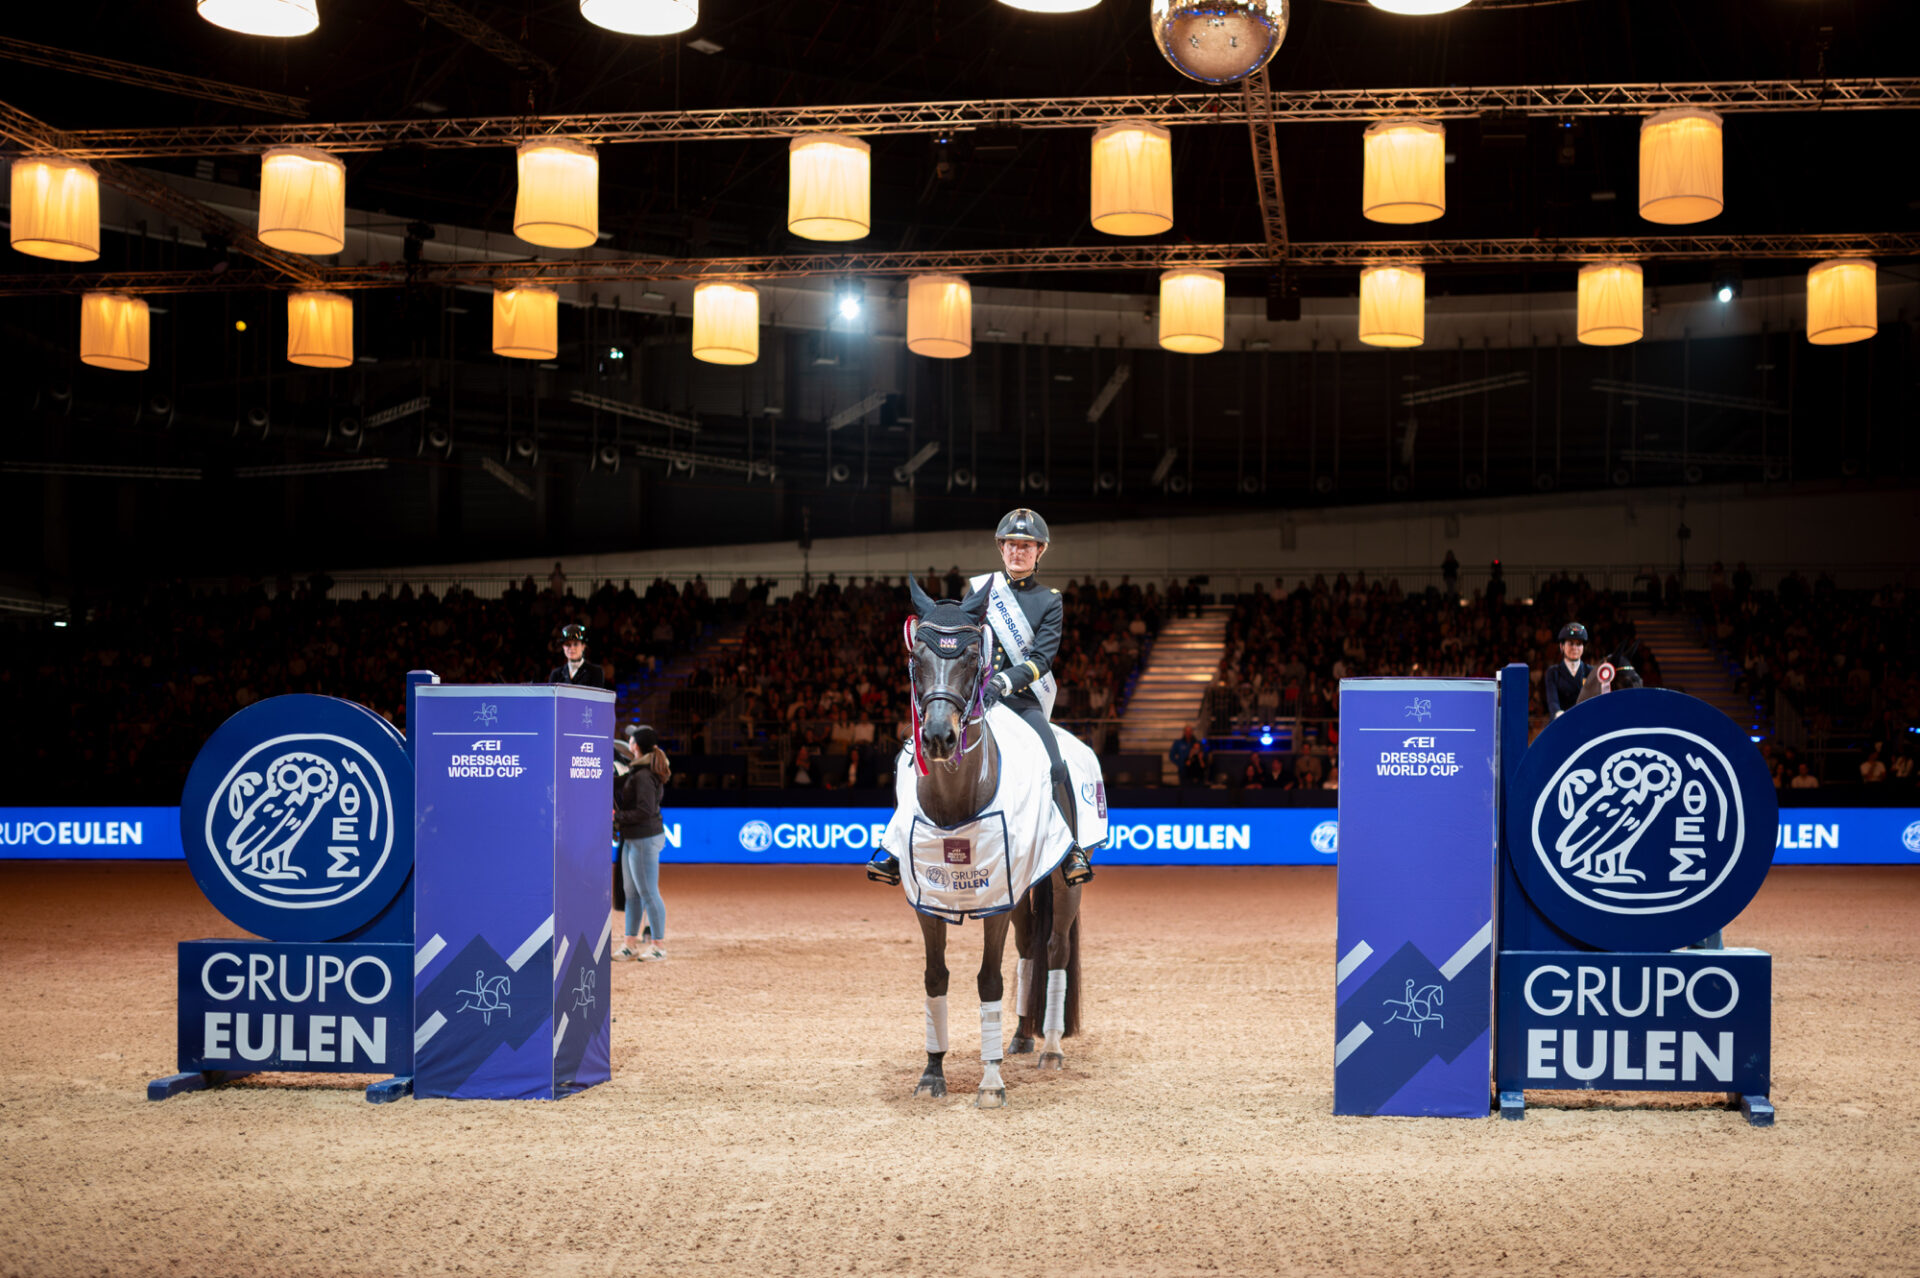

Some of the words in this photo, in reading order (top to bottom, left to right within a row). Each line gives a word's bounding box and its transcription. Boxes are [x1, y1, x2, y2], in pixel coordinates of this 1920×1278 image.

[996, 600, 1025, 647] DRESSAGE
[472, 740, 500, 750] FEI
[1403, 737, 1434, 747] FEI
[452, 755, 519, 765] DRESSAGE
[572, 756, 600, 767] DRESSAGE
[1381, 753, 1455, 763] DRESSAGE
[448, 767, 494, 777] WORLD
[570, 768, 591, 778] WORLD
[1377, 765, 1427, 775] WORLD
[59, 822, 141, 844] EULEN
[774, 824, 868, 848] GRUPO
[1157, 825, 1249, 849] EULEN
[951, 868, 989, 880] GRUPO
[953, 878, 989, 890] EULEN
[201, 951, 393, 1005] GRUPO
[1524, 965, 1740, 1019] GRUPO
[204, 1012, 387, 1064] EULEN
[1527, 1029, 1734, 1082] EULEN
